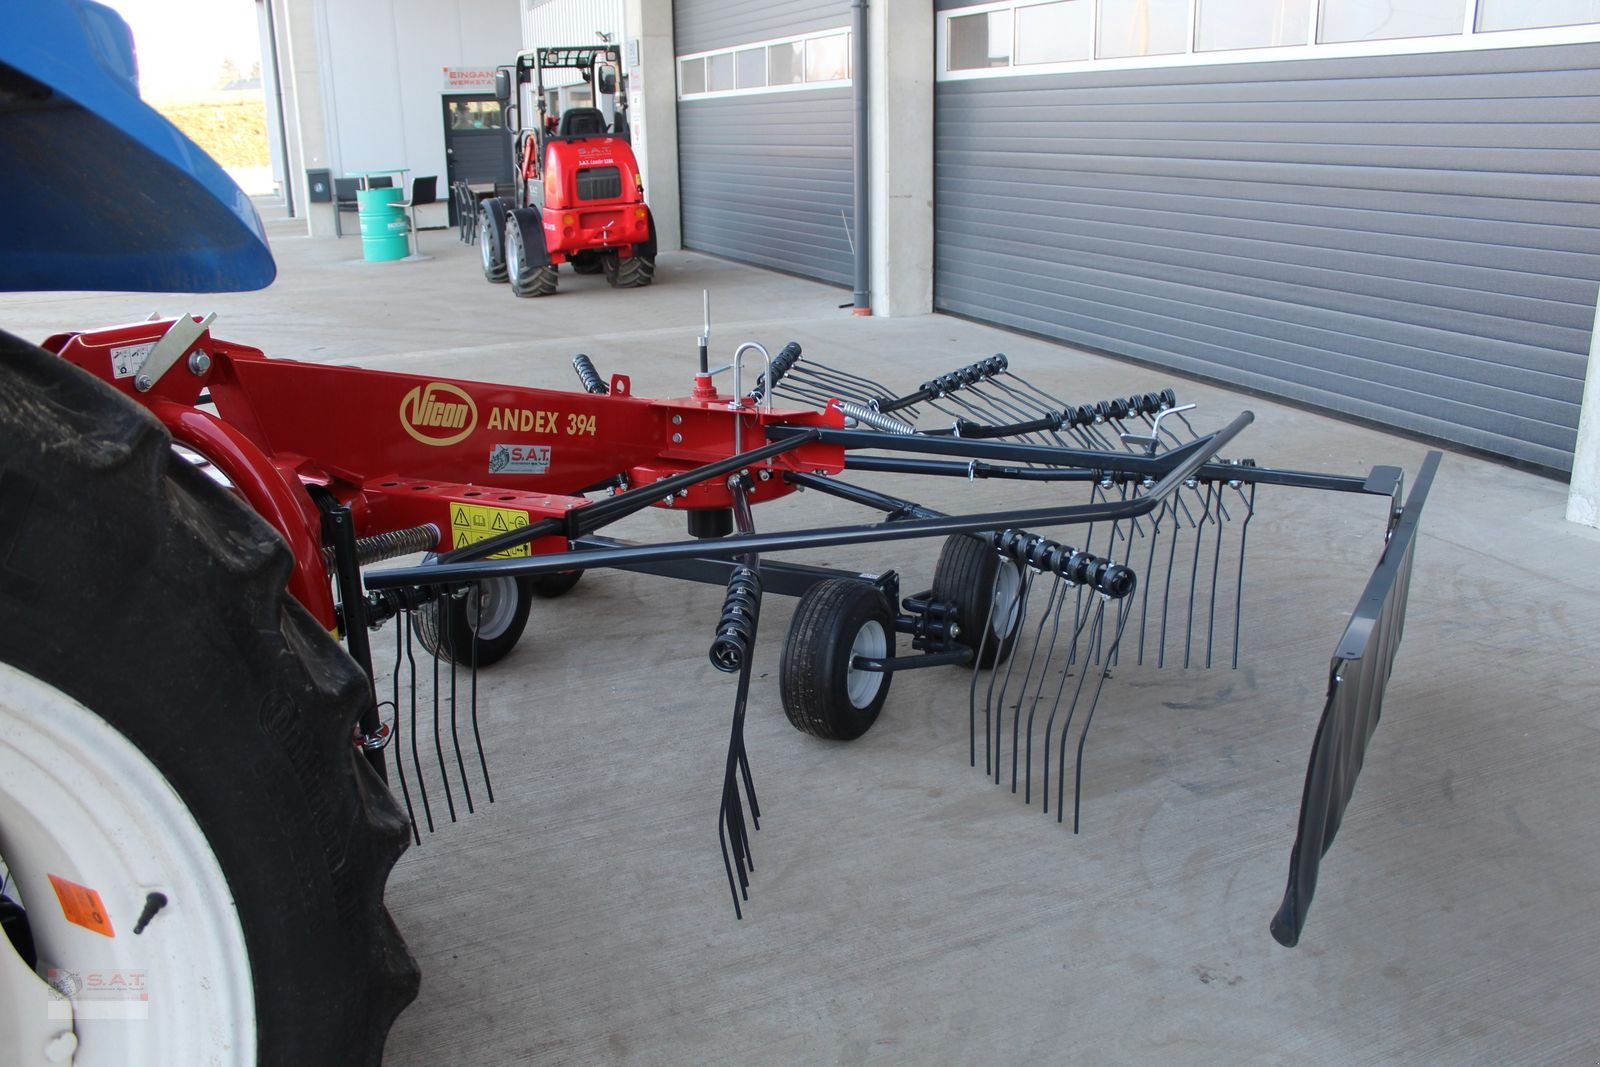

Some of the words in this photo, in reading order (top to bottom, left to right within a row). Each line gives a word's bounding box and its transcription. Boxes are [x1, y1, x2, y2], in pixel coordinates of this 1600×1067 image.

[448, 71, 497, 79] EINGAN
[411, 384, 469, 429] Vicon
[487, 407, 558, 434] ANDEX
[566, 413, 597, 436] 394
[511, 447, 550, 461] S.A.T.
